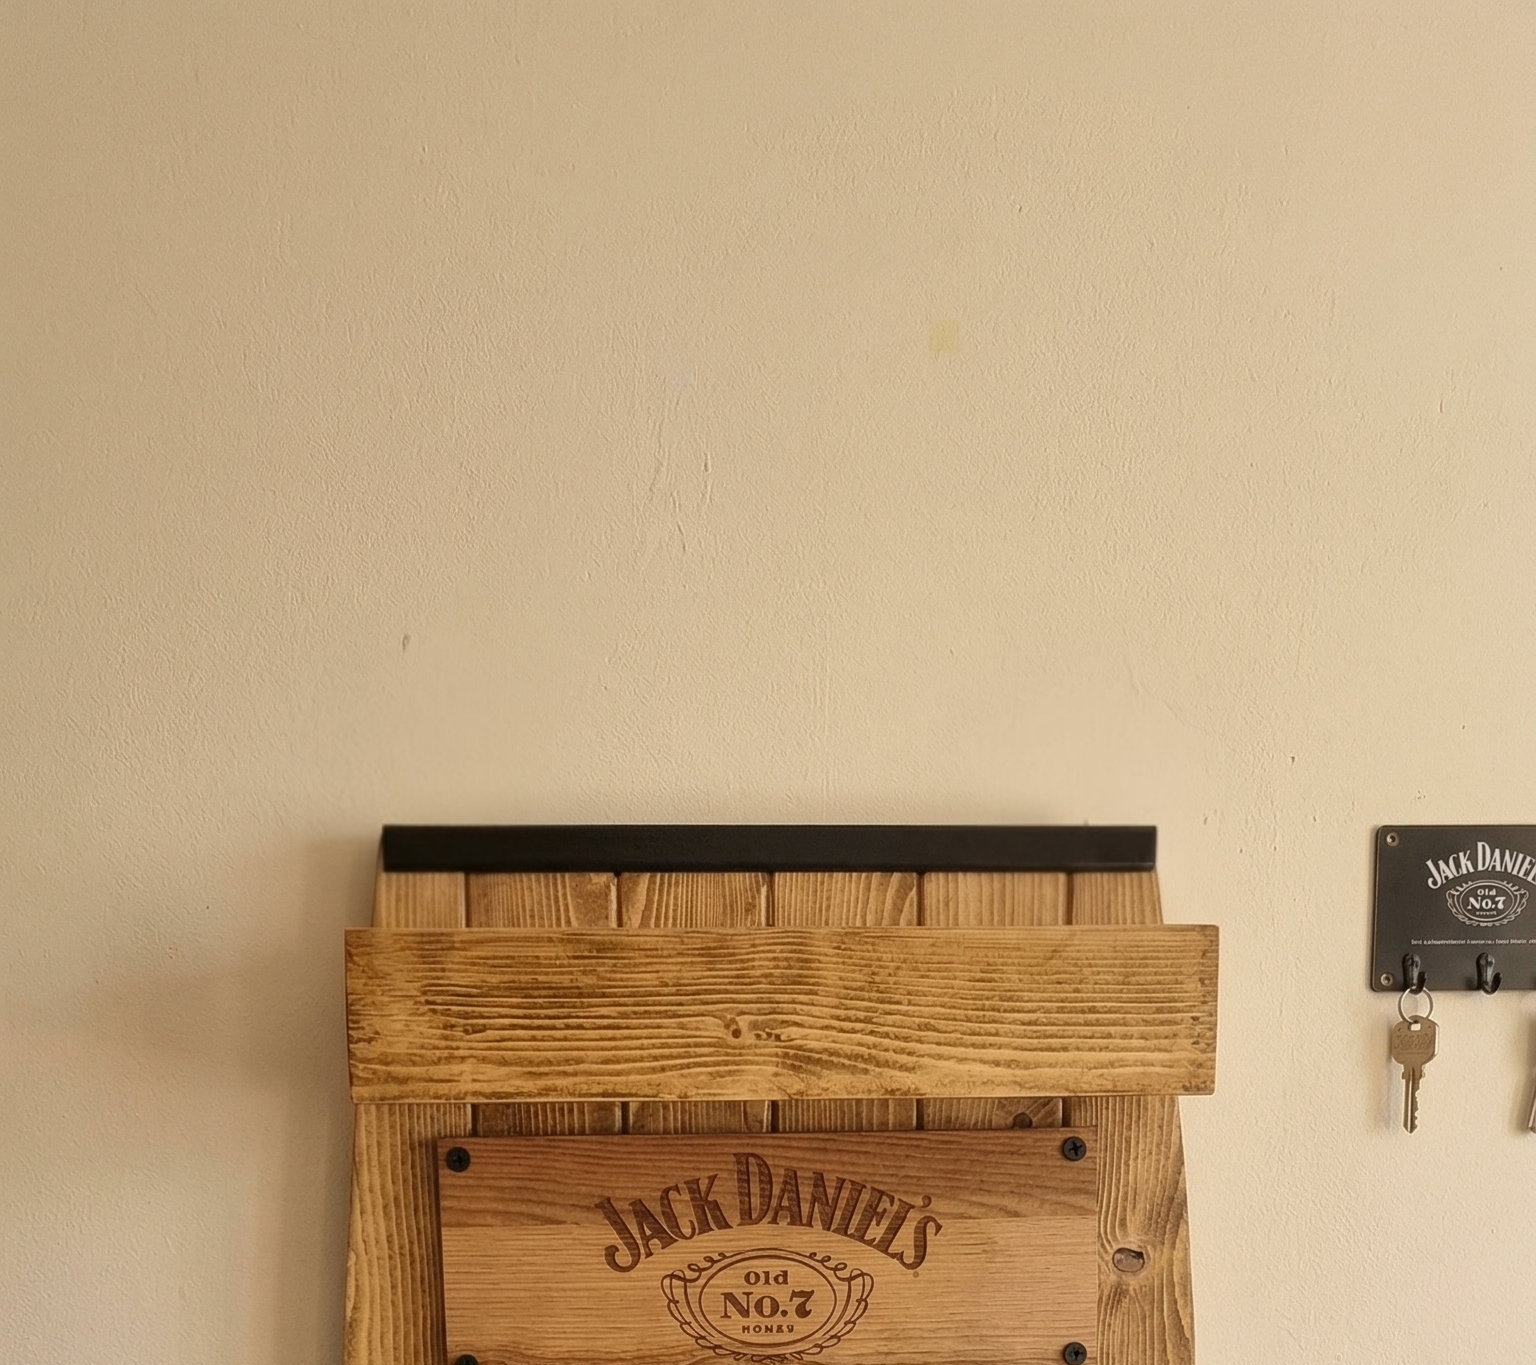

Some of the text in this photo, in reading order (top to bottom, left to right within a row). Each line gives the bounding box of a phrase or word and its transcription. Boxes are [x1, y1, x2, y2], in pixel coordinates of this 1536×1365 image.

[1425, 850, 1475, 889] JACK
[1467, 896, 1506, 910] No.7
[1477, 888, 1496, 896] Old
[594, 1152, 943, 1273] JACK DANIEL'S
[743, 1269, 789, 1286] Old
[720, 1289, 815, 1320] No.7
